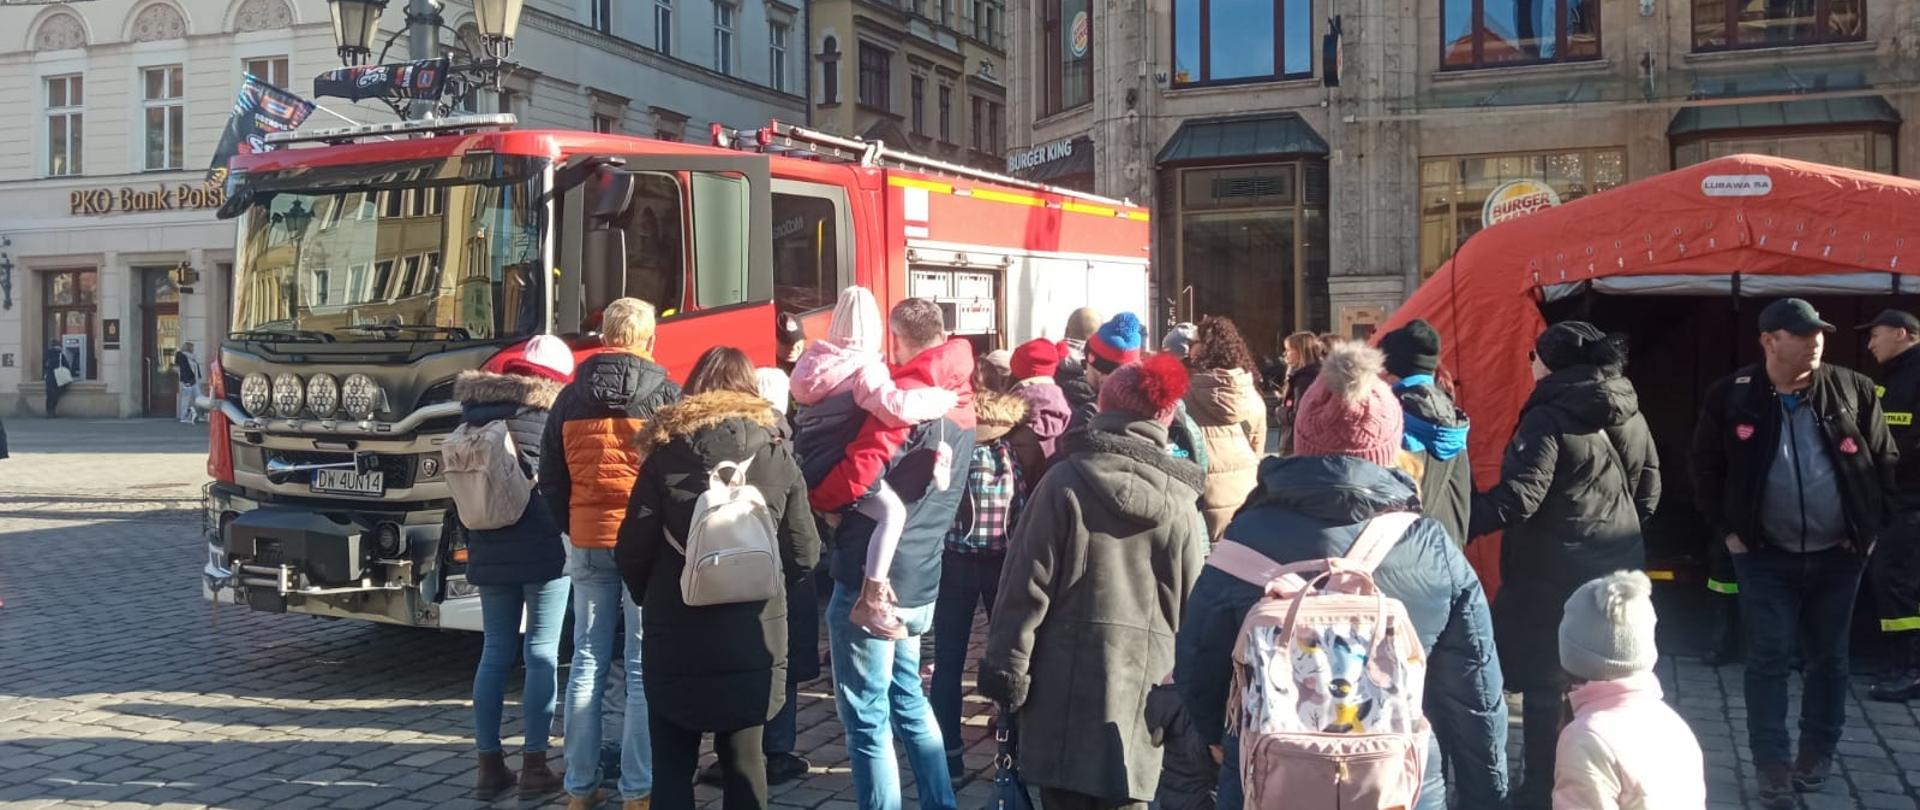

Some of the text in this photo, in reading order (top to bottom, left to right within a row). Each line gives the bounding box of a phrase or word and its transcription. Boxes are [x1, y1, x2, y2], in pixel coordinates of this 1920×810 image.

[1008, 139, 1072, 172] BURGER KING
[1704, 181, 1750, 189] LUBAWA
[70, 188, 113, 215] PKO
[120, 183, 171, 211] Bank
[1493, 192, 1550, 217] BURGER
[319, 471, 380, 491] DW 4UN14
